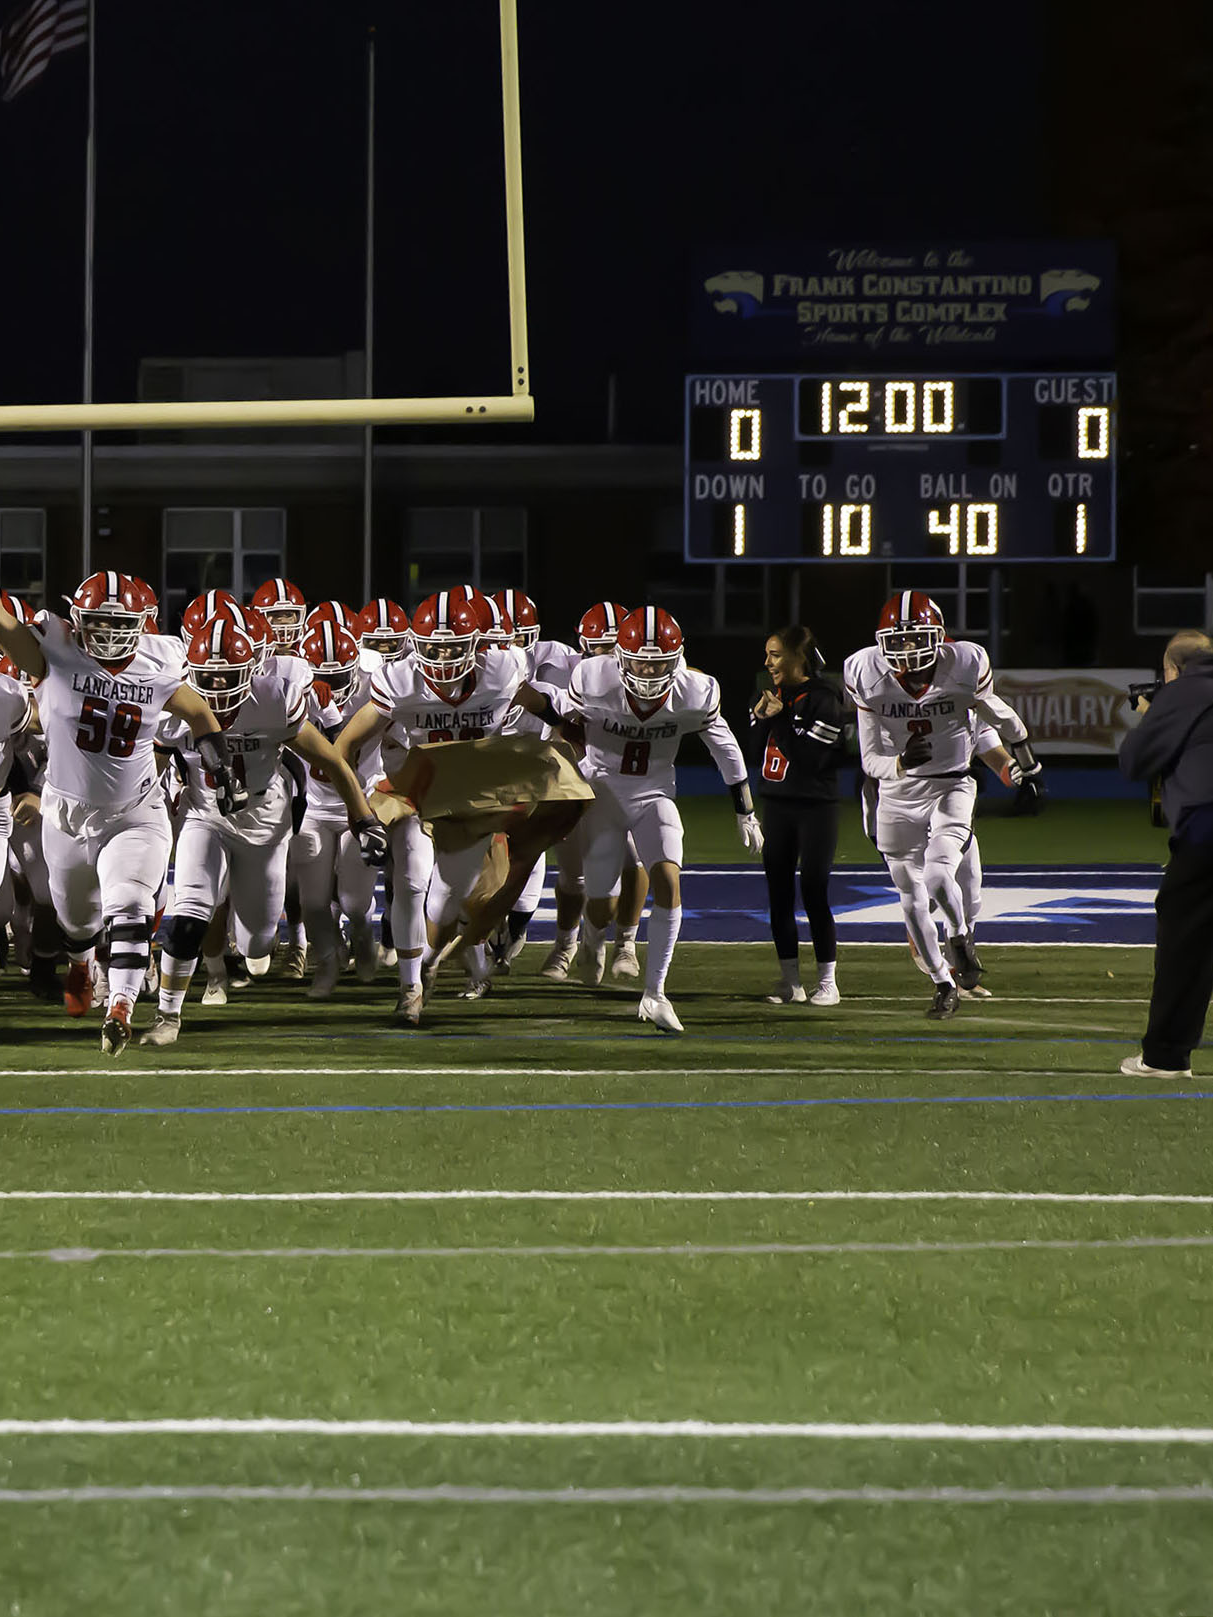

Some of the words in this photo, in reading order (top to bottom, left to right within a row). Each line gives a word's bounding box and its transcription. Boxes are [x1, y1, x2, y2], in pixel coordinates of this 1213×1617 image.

[772, 274, 855, 297] FRANK
[862, 273, 1033, 296] CONSTANTINO
[797, 301, 888, 323] SPORTS
[895, 300, 1008, 323] COMPLEX
[695, 380, 760, 405] HOME
[1034, 378, 1113, 404] GUEST
[729, 408, 762, 461] 0
[1077, 407, 1109, 459] 0
[695, 475, 765, 499] DOWN
[799, 475, 827, 499] TO
[845, 475, 877, 499] GO
[920, 474, 973, 498] BALL
[989, 473, 1018, 498] ON
[1047, 473, 1093, 498] QTR
[733, 503, 746, 556] 1
[821, 503, 872, 556] 10
[927, 502, 999, 556] 40
[1075, 502, 1087, 555] 1
[71, 673, 155, 705] LANCASTER
[415, 710, 495, 729] LANCASTER
[881, 701, 955, 718] LANCASTER
[75, 695, 143, 758] 59
[602, 718, 679, 740] LANCASTER
